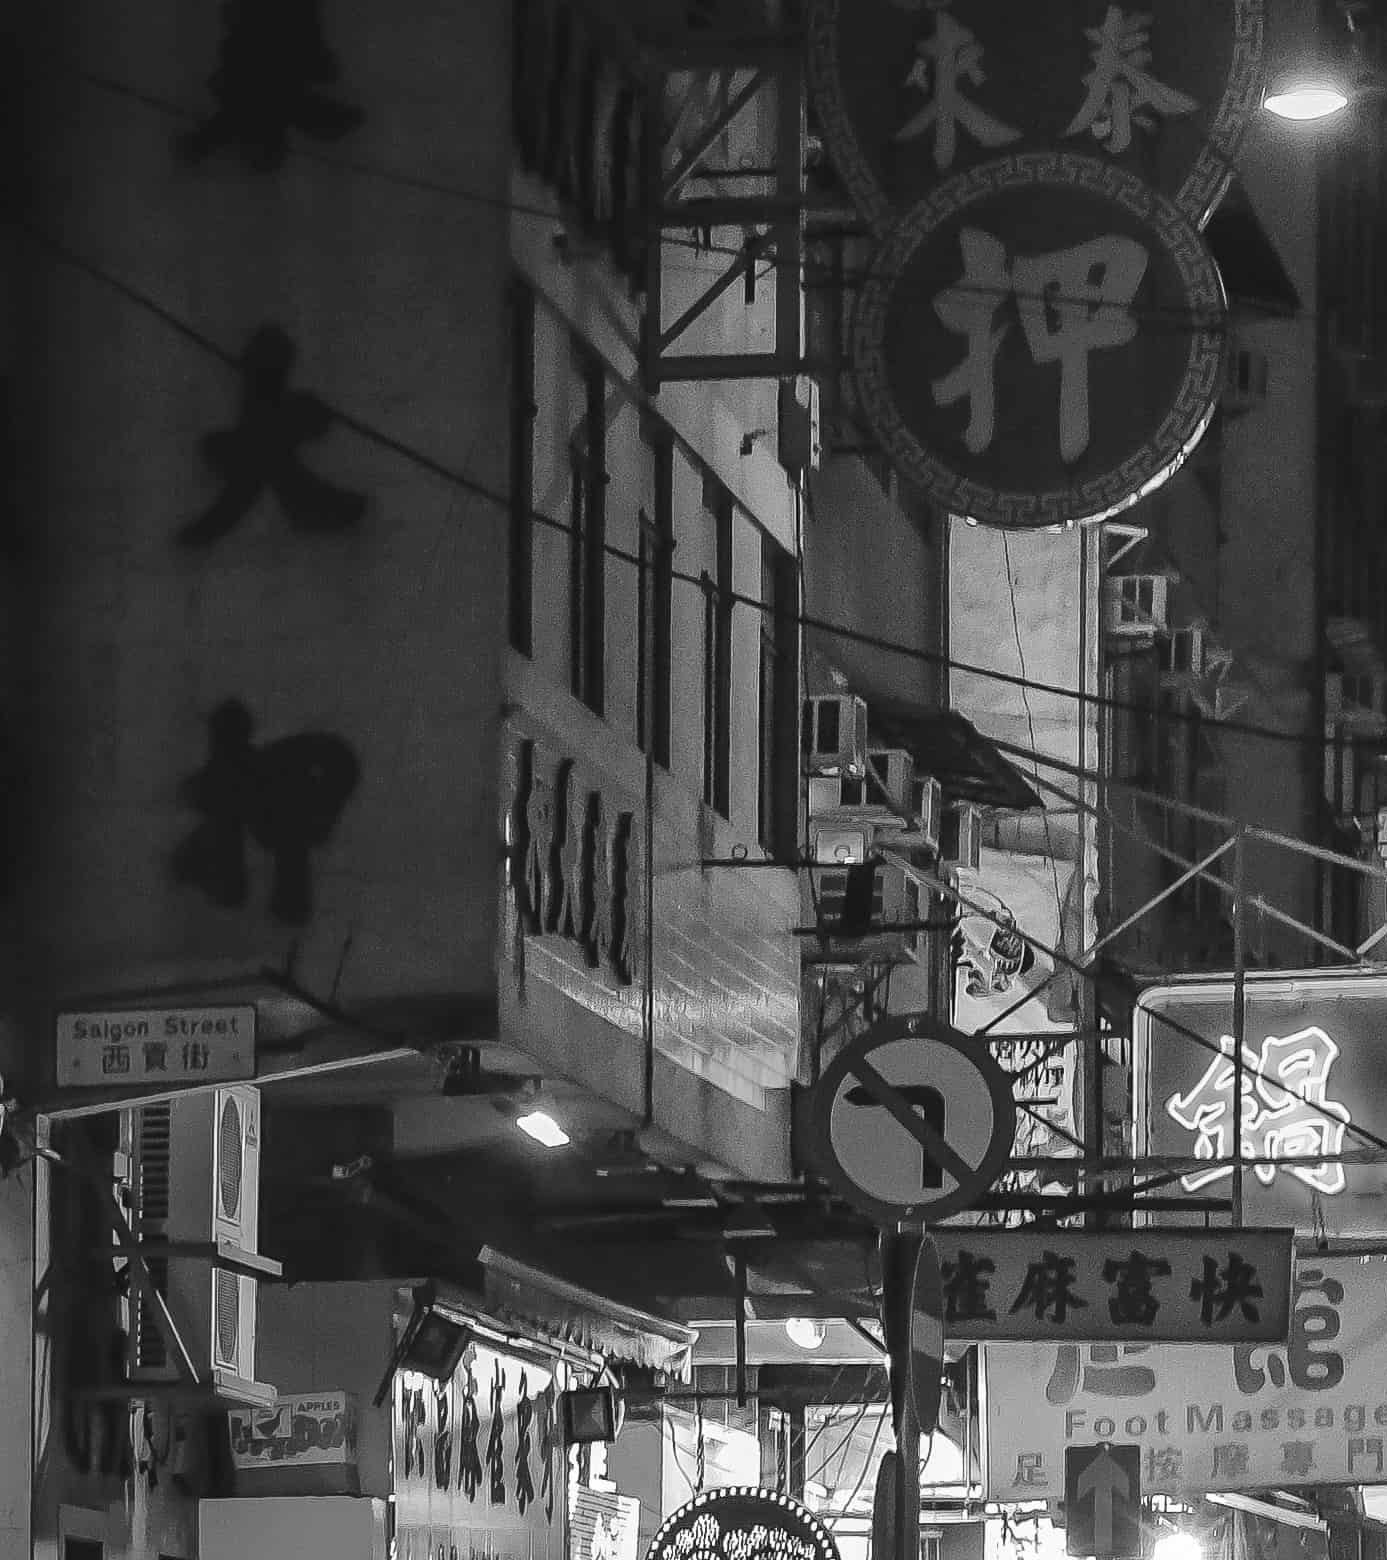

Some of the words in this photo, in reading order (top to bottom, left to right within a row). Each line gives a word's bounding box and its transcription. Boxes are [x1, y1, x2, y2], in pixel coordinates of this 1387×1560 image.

[928, 225, 1154, 465] 押
[72, 1018, 149, 1041] Saigon
[164, 1015, 240, 1036] Street
[102, 1041, 209, 1074] 西貢街
[1064, 1405, 1170, 1439] Foot
